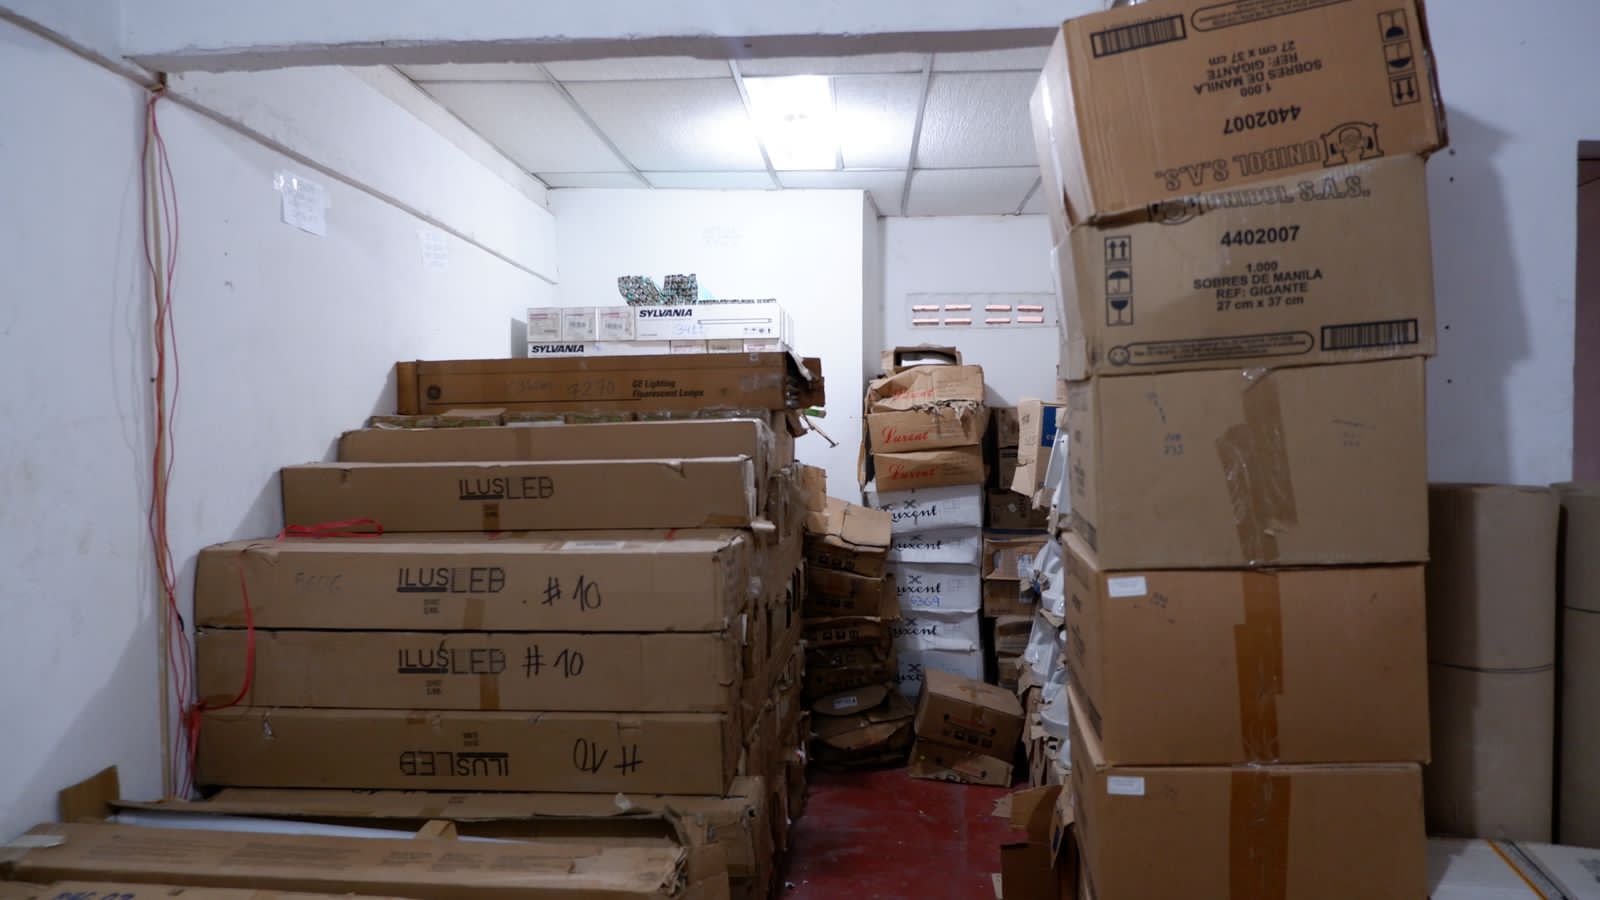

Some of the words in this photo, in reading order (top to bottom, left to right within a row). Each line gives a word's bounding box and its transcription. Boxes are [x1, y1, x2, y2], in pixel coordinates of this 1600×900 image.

[1248, 49, 1255, 57] x
[1258, 44, 1277, 56] cm
[1282, 40, 1297, 52] 27
[1208, 55, 1227, 66] cm
[1231, 51, 1245, 63] 37
[1268, 52, 1298, 66] REF:
[1207, 60, 1265, 80] GIGANTE
[1247, 71, 1265, 83] DE
[1267, 58, 1322, 80] SOBRES
[1193, 76, 1244, 95] MANILA
[1240, 82, 1272, 97] 1.000
[1223, 104, 1301, 135] 4402007
[1232, 139, 1321, 177] UNIBOL
[1155, 159, 1229, 192] S.A.S.
[1220, 225, 1300, 247] 4402007
[1246, 261, 1278, 273] 1.000
[1193, 275, 1248, 290] SOBRES
[1251, 273, 1270, 285] DE
[1273, 268, 1323, 283] MANILA
[1216, 287, 1246, 300] REF:
[1249, 282, 1309, 297] GIGANTE
[1216, 300, 1232, 312] 27
[1234, 300, 1254, 310] cm
[1256, 299, 1264, 308] x
[1267, 296, 1283, 308] 37
[1285, 295, 1304, 305] cm
[639, 308, 693, 318] SYLVANIA
[531, 344, 585, 354] SYLVANIA
[572, 575, 602, 611] 10
[553, 648, 584, 679] 10
